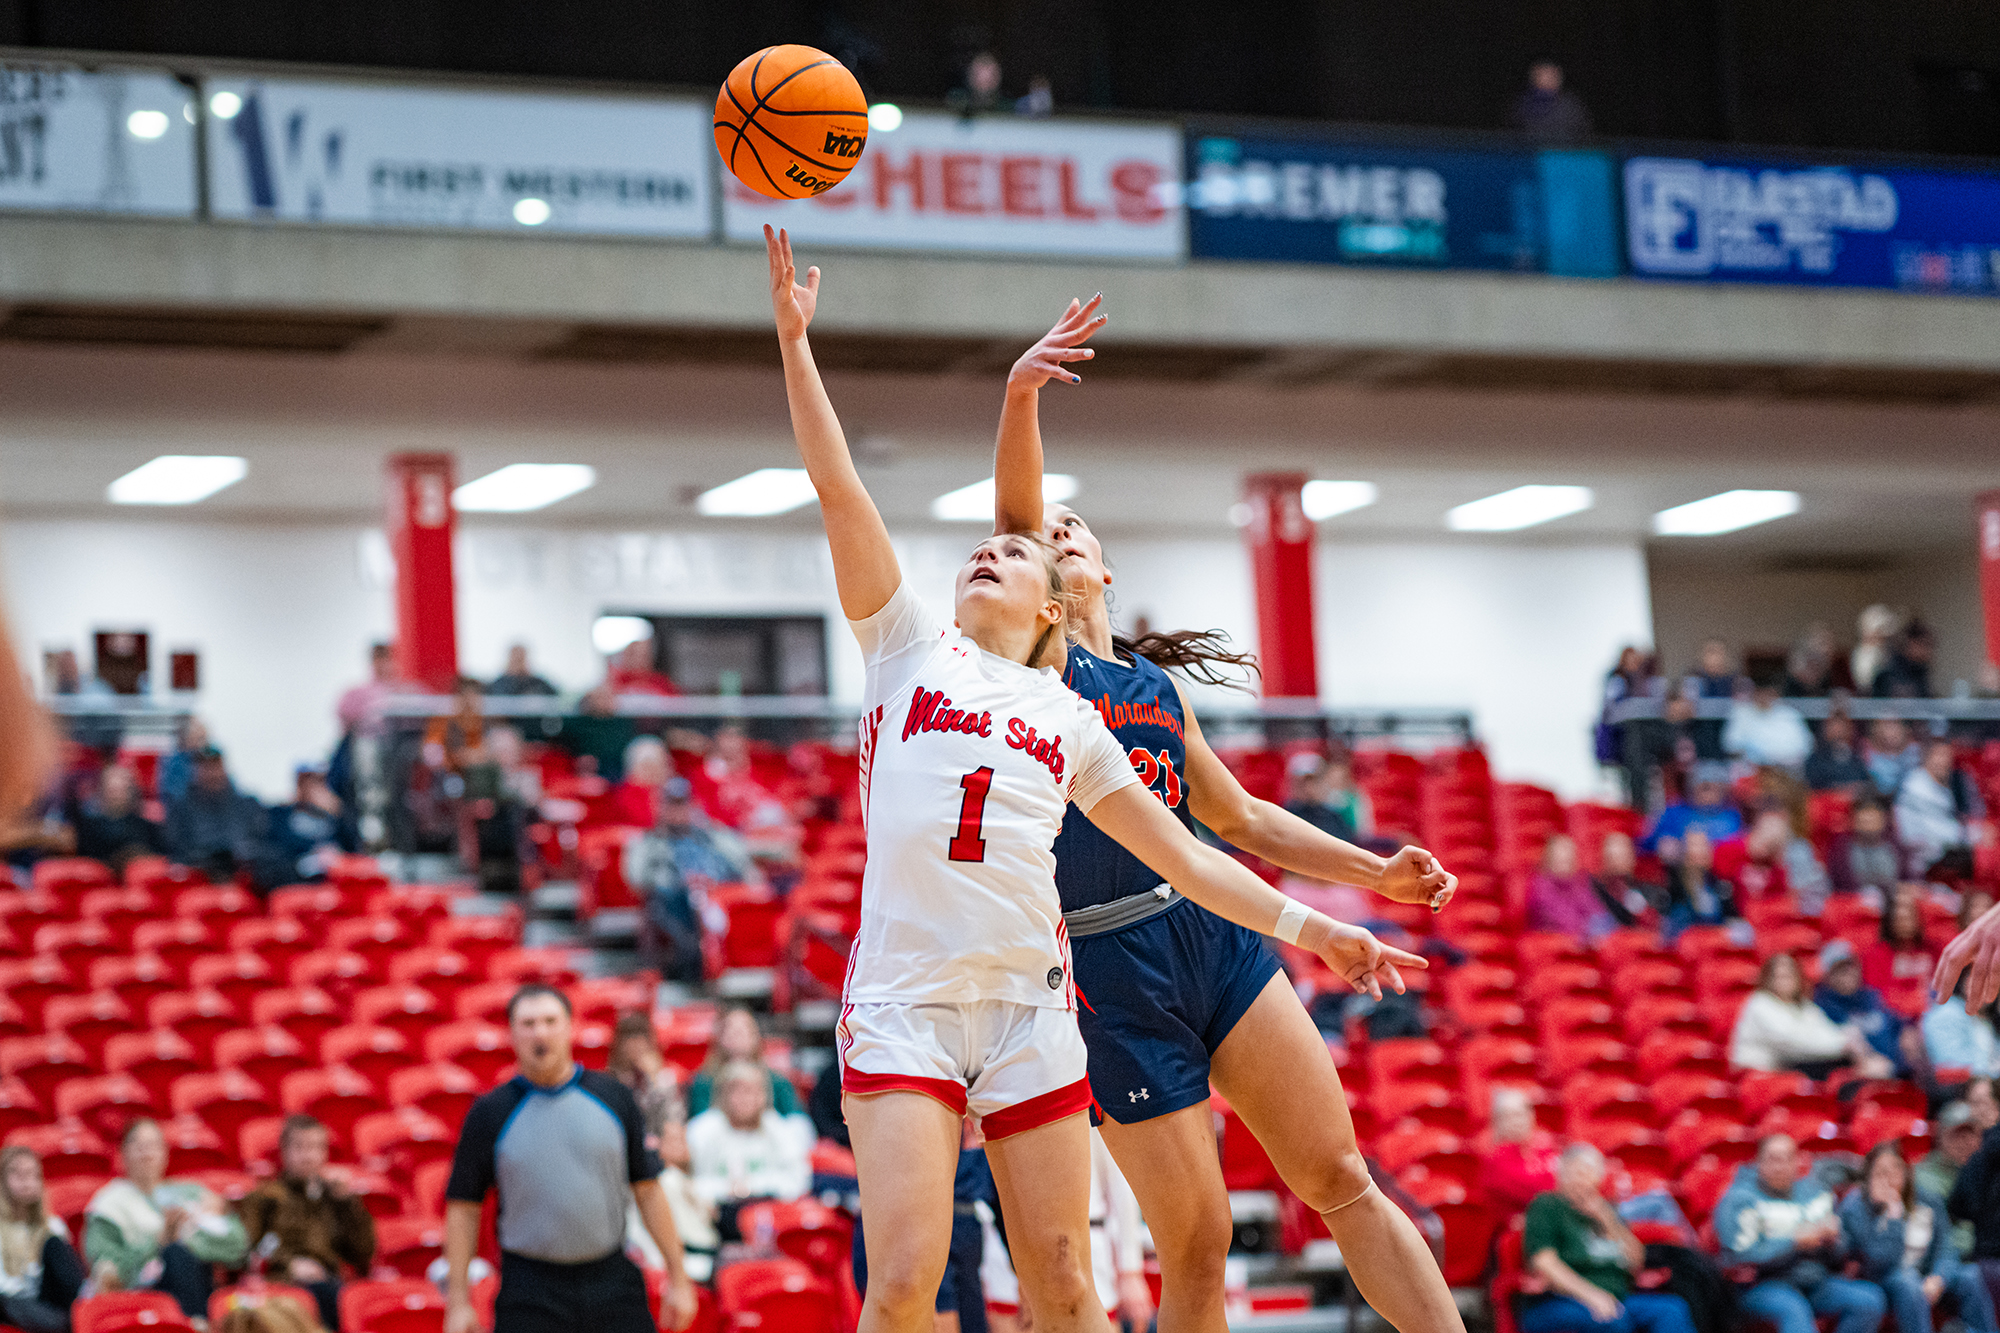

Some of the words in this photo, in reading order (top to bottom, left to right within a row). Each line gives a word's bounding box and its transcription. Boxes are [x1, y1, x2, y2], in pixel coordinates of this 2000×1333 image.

[368, 158, 484, 194] FIRST
[503, 166, 695, 206] WESTERN
[730, 146, 1168, 224] HEELS
[785, 162, 841, 196] lson
[902, 686, 992, 743] Minot
[1005, 717, 1065, 784] State
[1128, 747, 1183, 809] 21
[948, 765, 995, 863] 1
